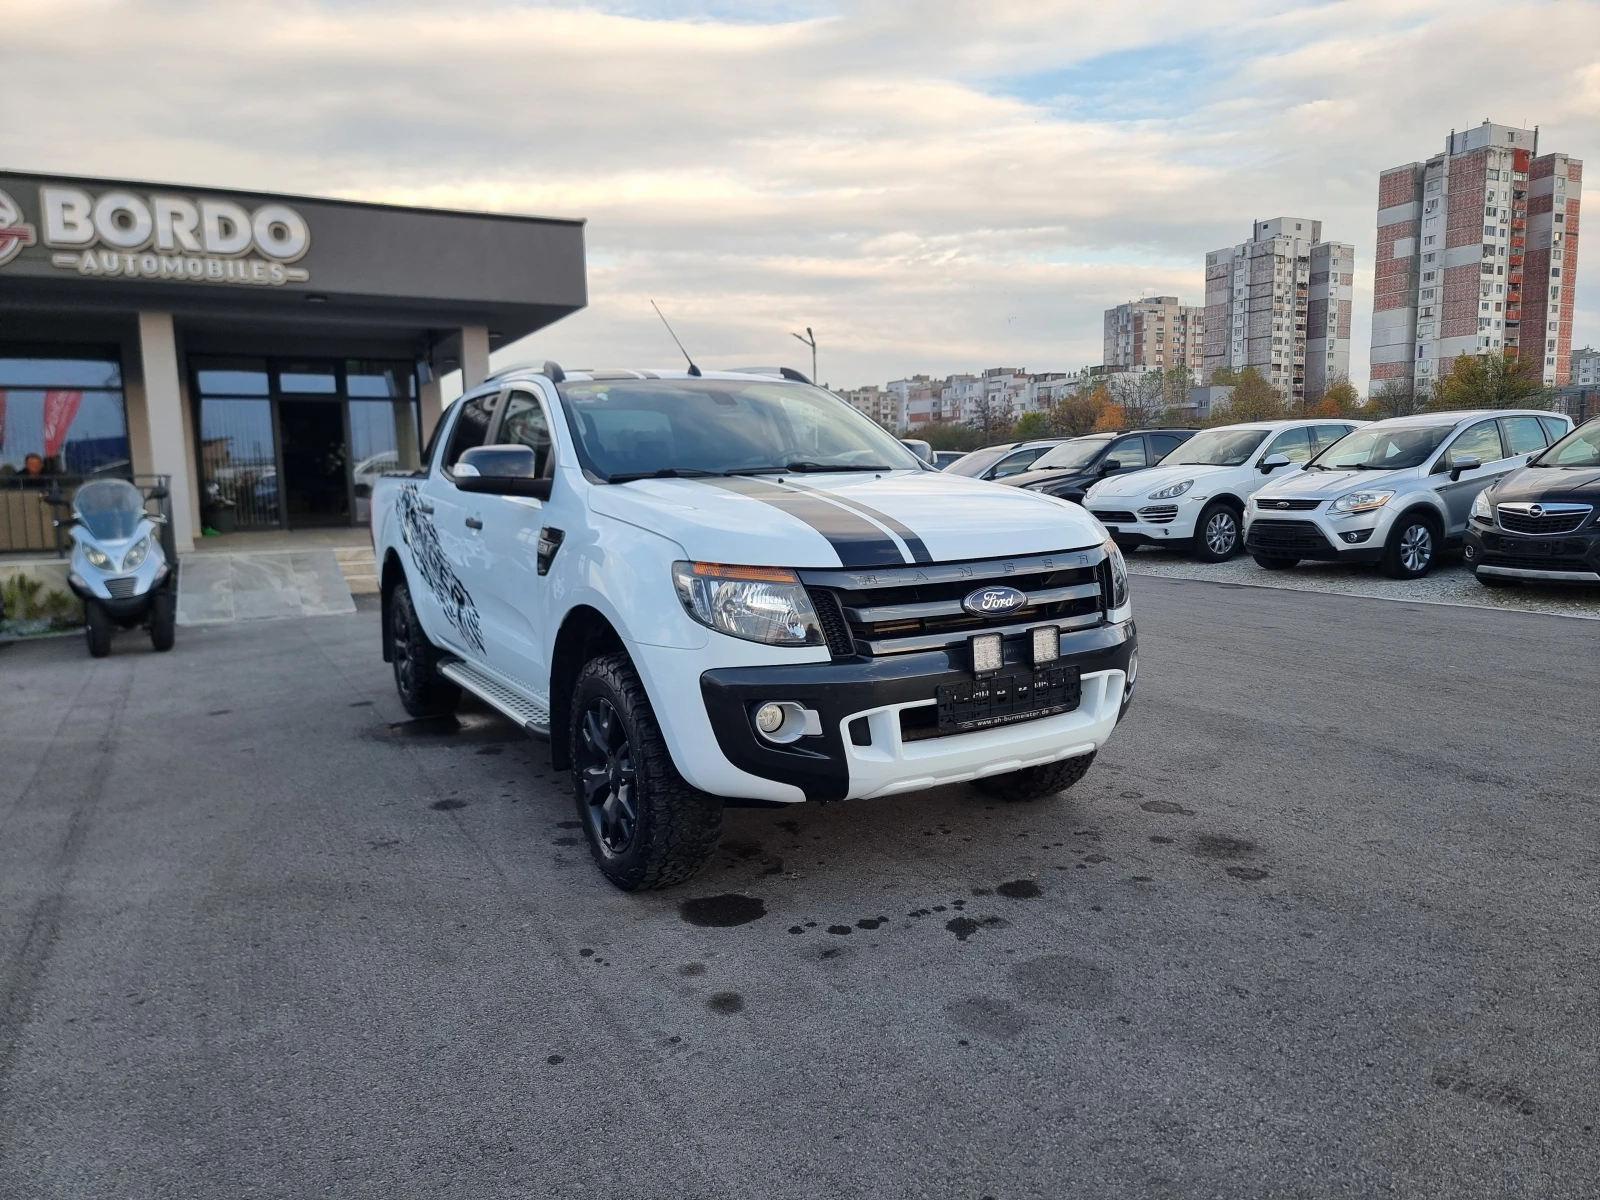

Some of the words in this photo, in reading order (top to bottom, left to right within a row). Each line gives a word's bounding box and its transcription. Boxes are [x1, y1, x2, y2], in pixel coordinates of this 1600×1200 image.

[42, 186, 308, 260] BORDO
[80, 252, 286, 283] AUTOMOBILES
[862, 552, 1089, 586] RANGER
[982, 591, 1015, 609] Ford
